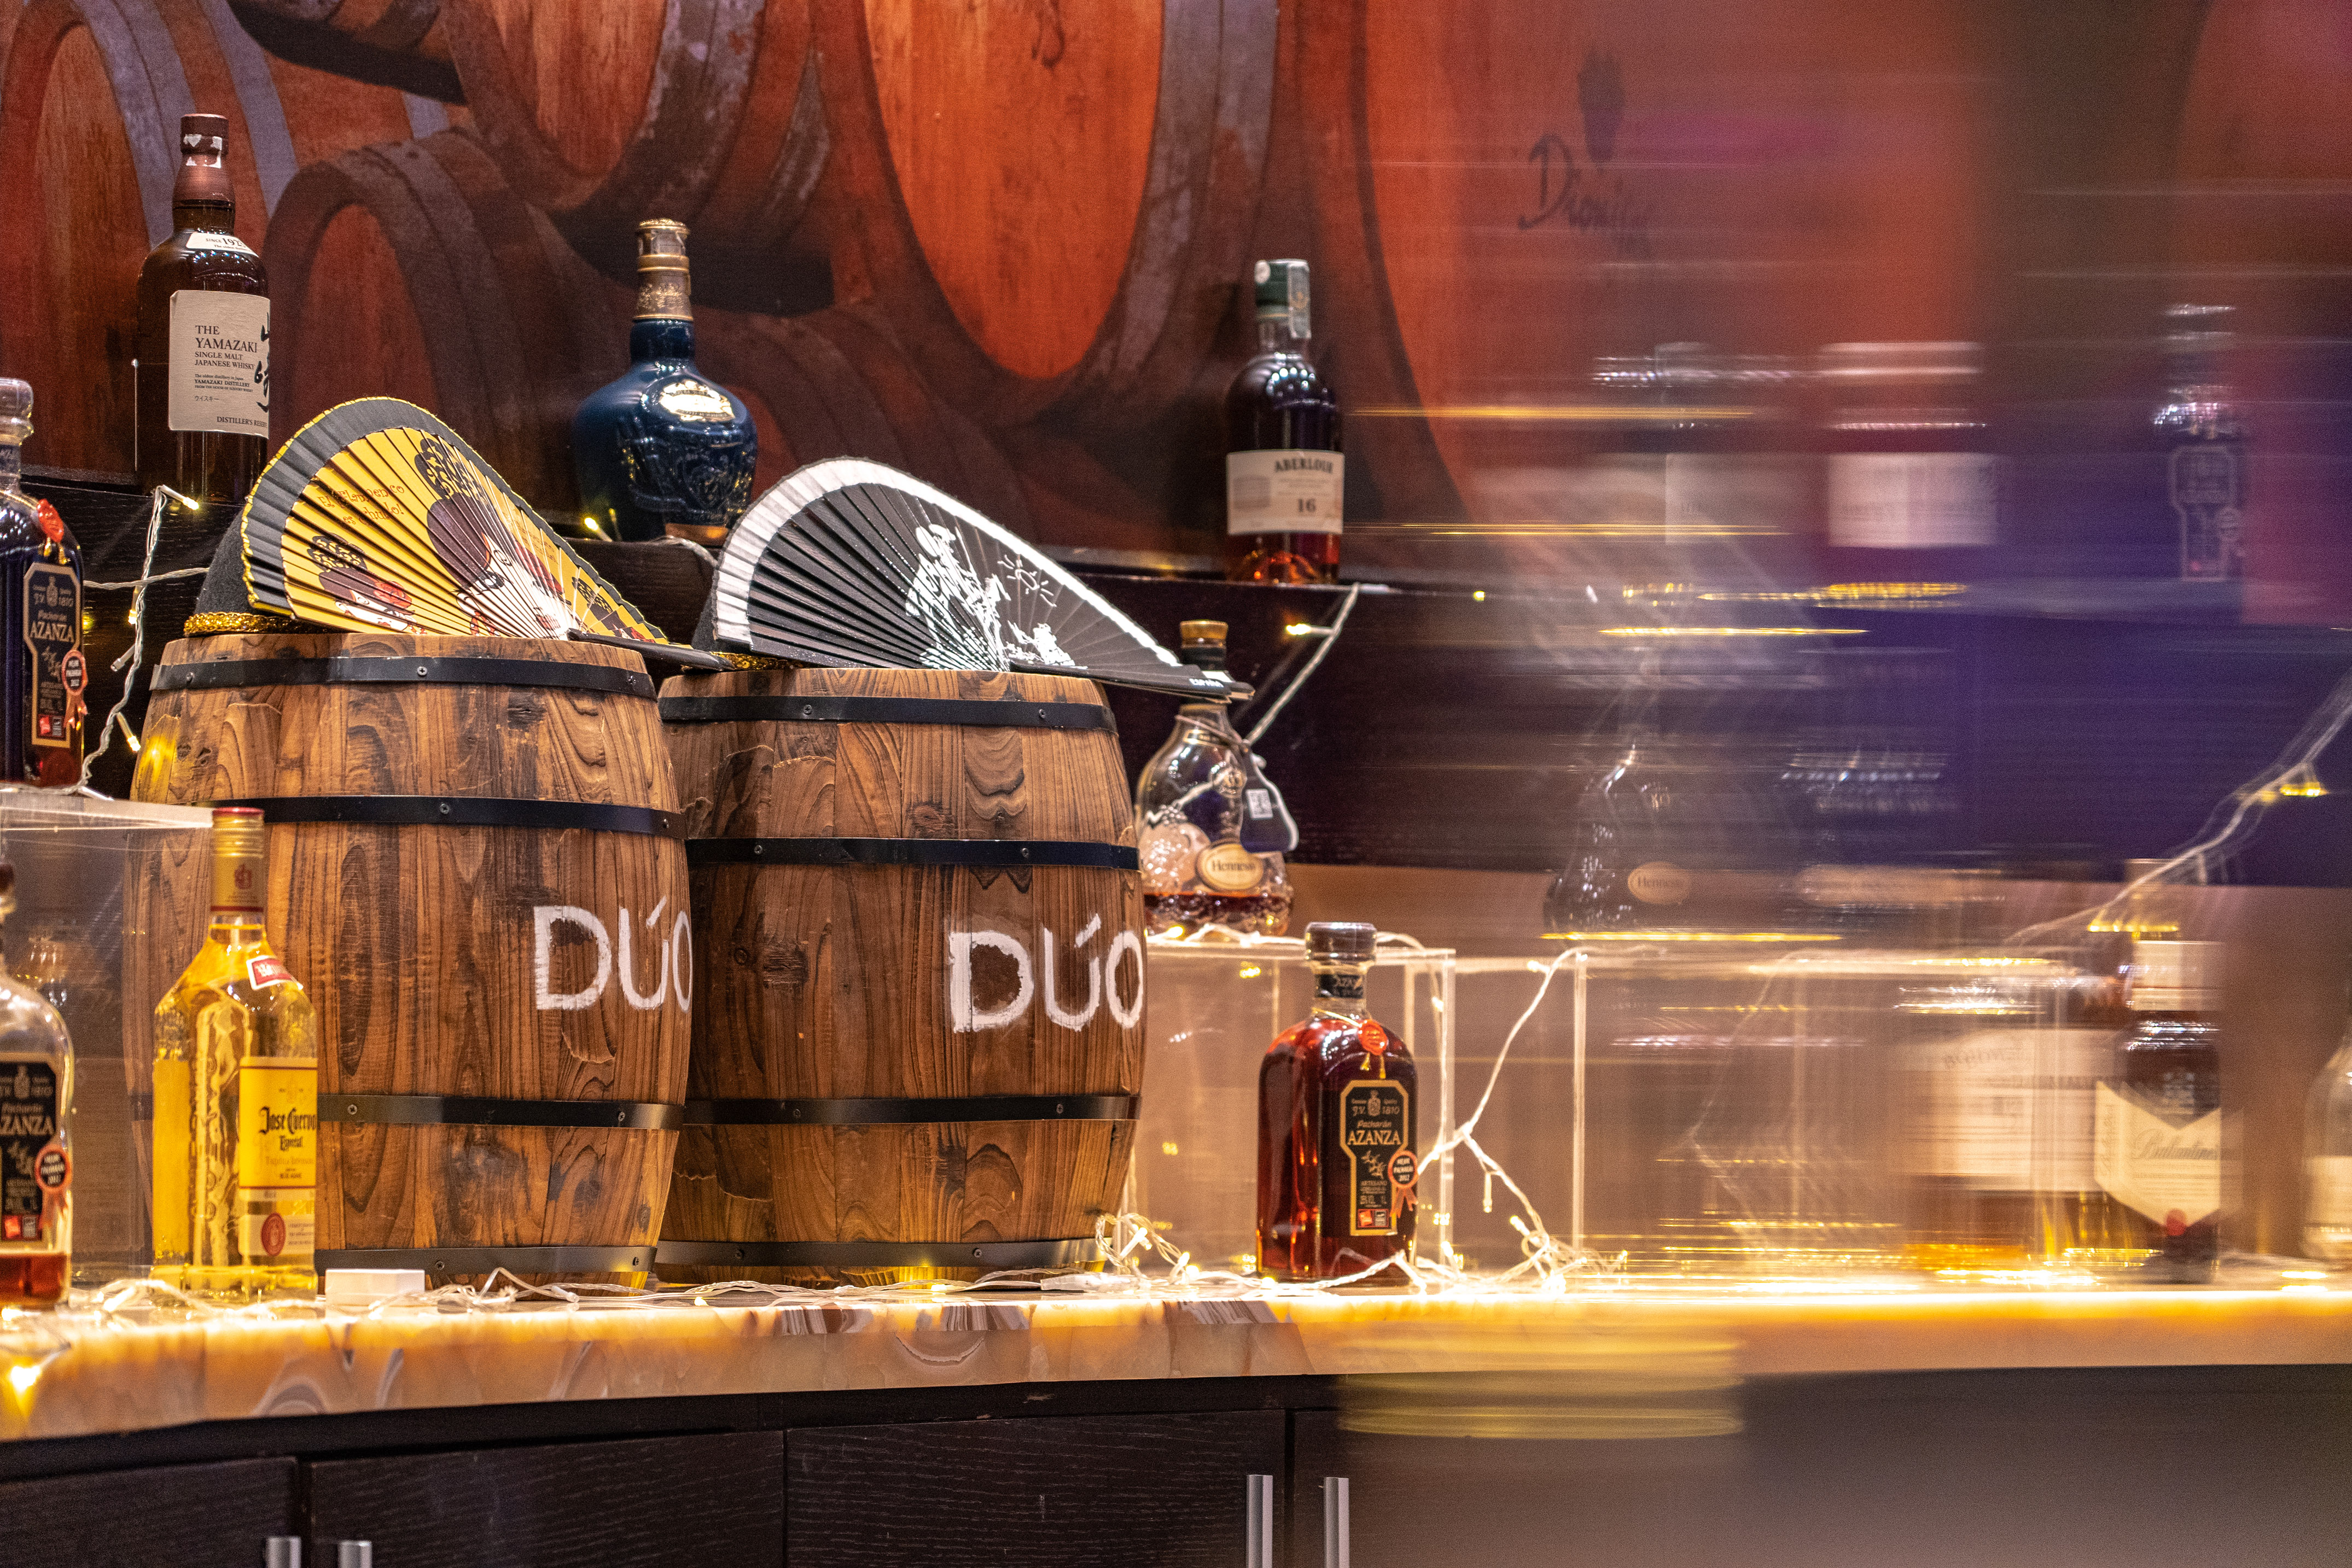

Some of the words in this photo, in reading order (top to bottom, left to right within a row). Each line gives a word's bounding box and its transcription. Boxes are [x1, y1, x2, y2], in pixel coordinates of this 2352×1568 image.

[195, 325, 220, 335] THE
[195, 337, 257, 353] YAMAZAKI
[195, 359, 231, 368] JAPANESE
[232, 362, 255, 370] WHISKY
[217, 416, 253, 425] DISTILLER'S
[317, 496, 335, 508] El
[1298, 498, 1317, 512] 16
[342, 516, 356, 524] es
[30, 621, 75, 643] AZANZA
[534, 896, 694, 1013] DÚO
[949, 912, 1143, 1033] DÚO
[0, 1115, 55, 1135] ZANZA
[1347, 1130, 1401, 1145] AZANZA
